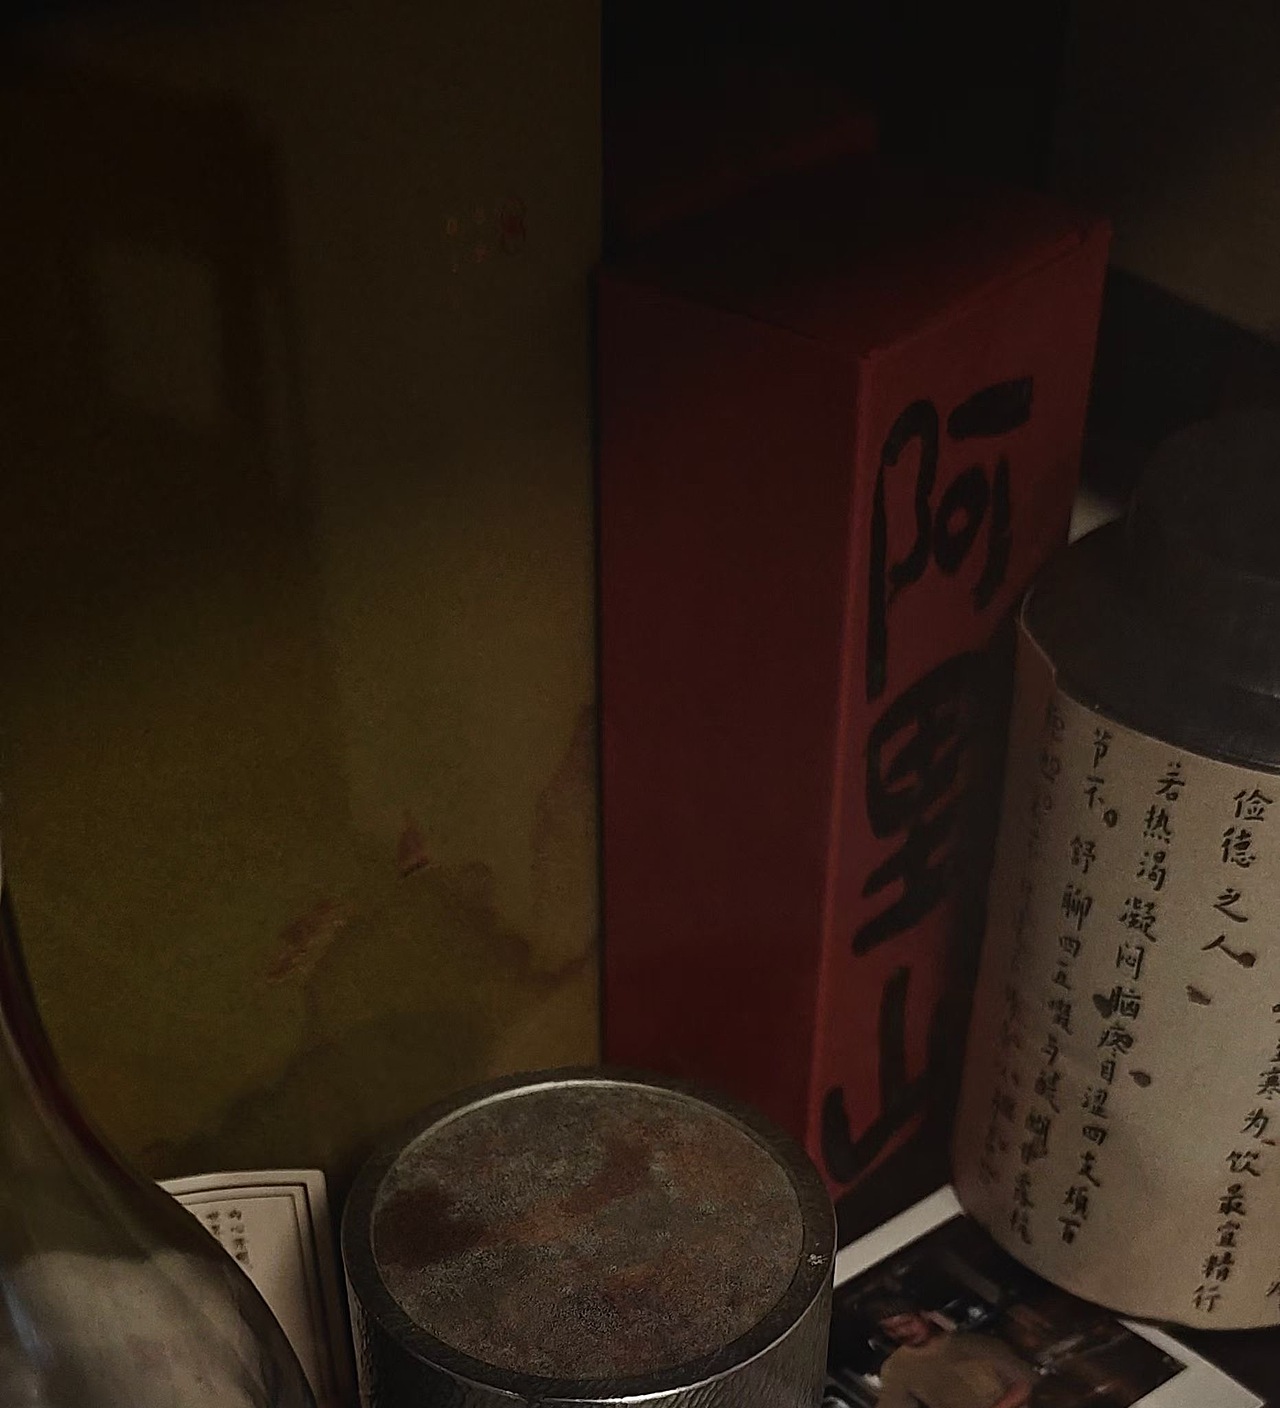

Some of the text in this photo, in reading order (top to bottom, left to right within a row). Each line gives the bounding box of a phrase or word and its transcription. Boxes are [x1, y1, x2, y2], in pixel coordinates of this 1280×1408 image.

[821, 376, 1033, 1183] 阿里山
[1202, 788, 1274, 968] 俭德之人
